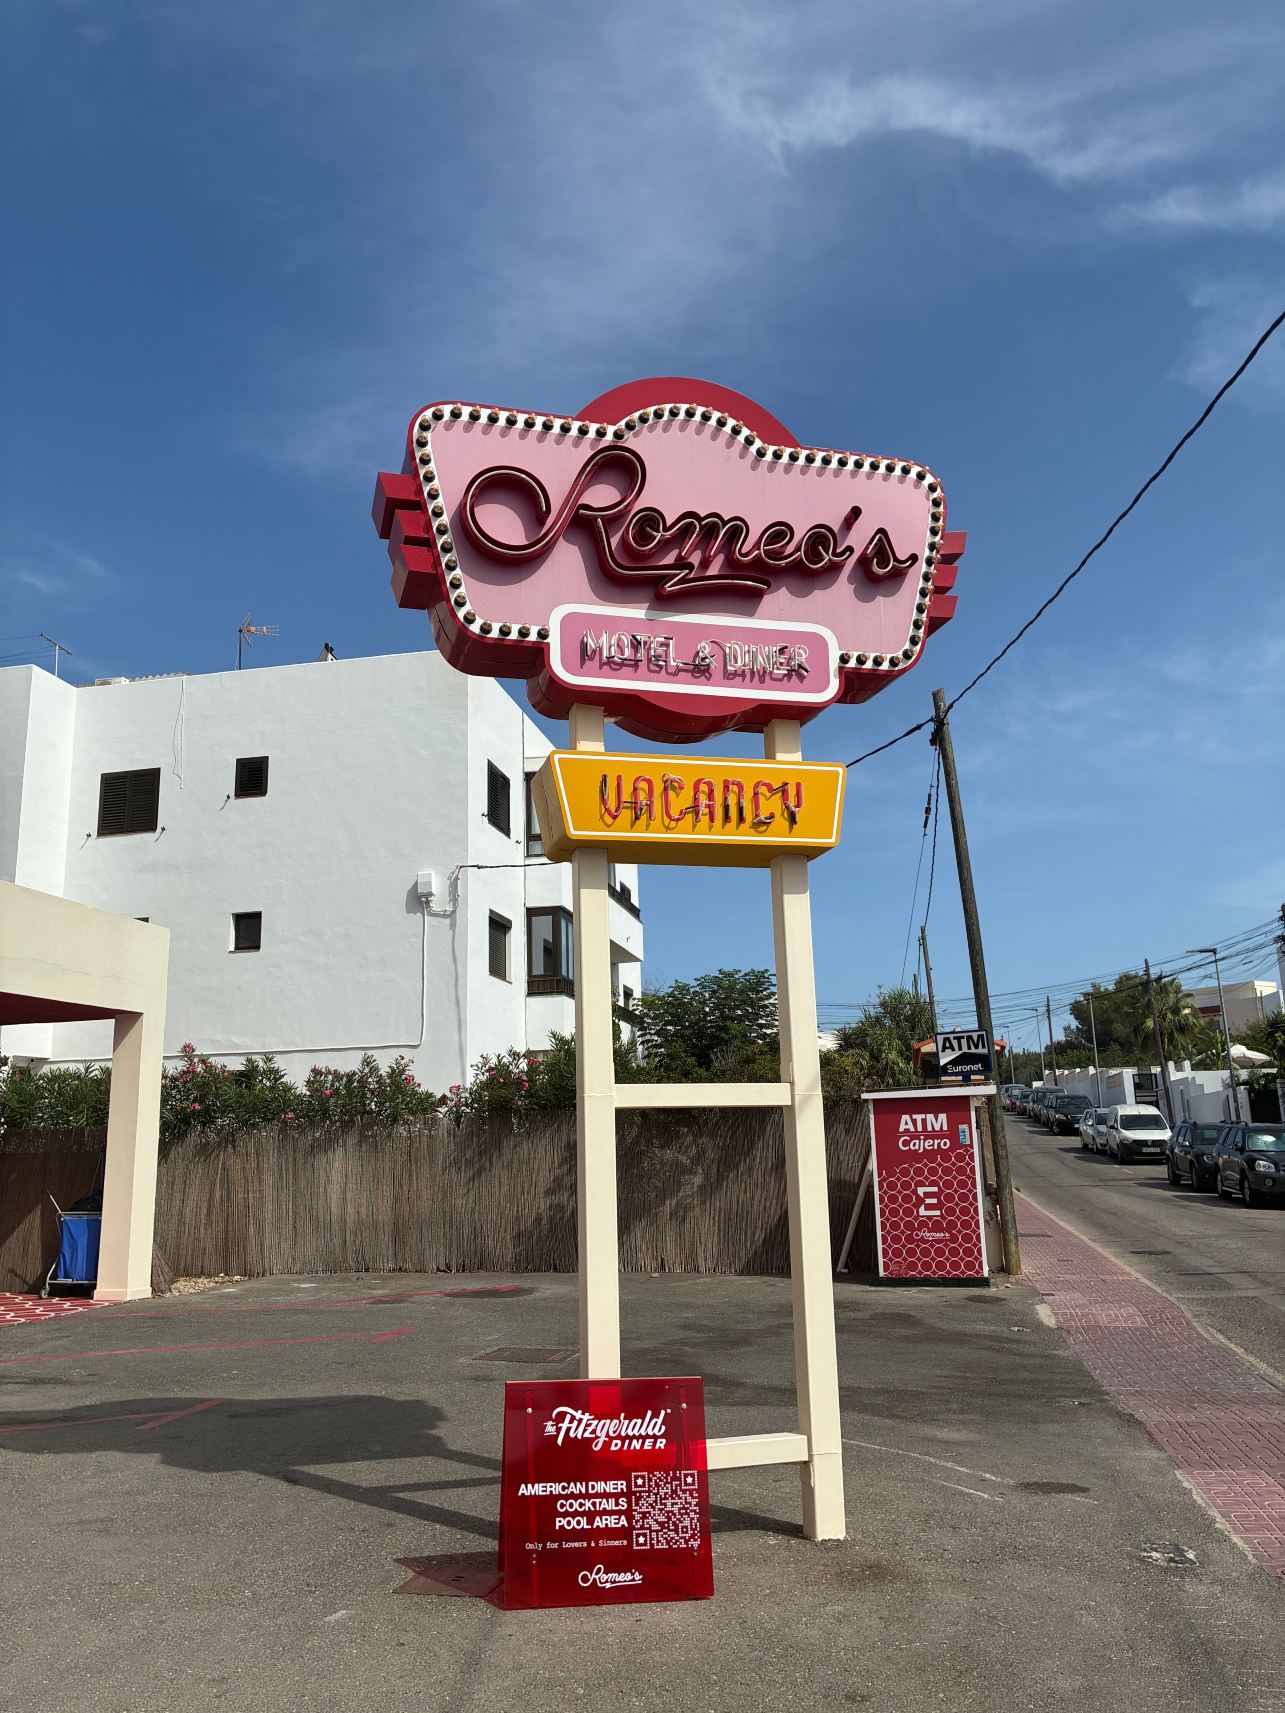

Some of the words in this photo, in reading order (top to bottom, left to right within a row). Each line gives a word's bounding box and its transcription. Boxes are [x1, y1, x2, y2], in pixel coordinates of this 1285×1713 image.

[460, 444, 918, 600] Romeo's
[582, 628, 678, 666] MOTEL
[697, 641, 717, 668] &
[725, 640, 811, 674] DINER
[600, 772, 804, 825] VACANCY
[941, 1033, 986, 1053] ATM
[947, 1062, 984, 1073] Euronet
[899, 1113, 948, 1132] ATM
[898, 1135, 951, 1153] Cajero
[913, 1227, 951, 1240] Romeo's
[552, 1406, 666, 1451] Fitzgerald
[610, 1438, 667, 1451] DINER
[518, 1481, 586, 1496] AMERICAN
[588, 1480, 627, 1494] DINER
[556, 1497, 628, 1513] COCKTAILS
[555, 1516, 592, 1530] POOL
[593, 1515, 629, 1529] AREA
[525, 1542, 543, 1551] Only
[546, 1541, 559, 1549] for
[562, 1540, 588, 1548] Lovers
[598, 1538, 628, 1547] Sinners
[578, 1564, 643, 1589] Romeo's
